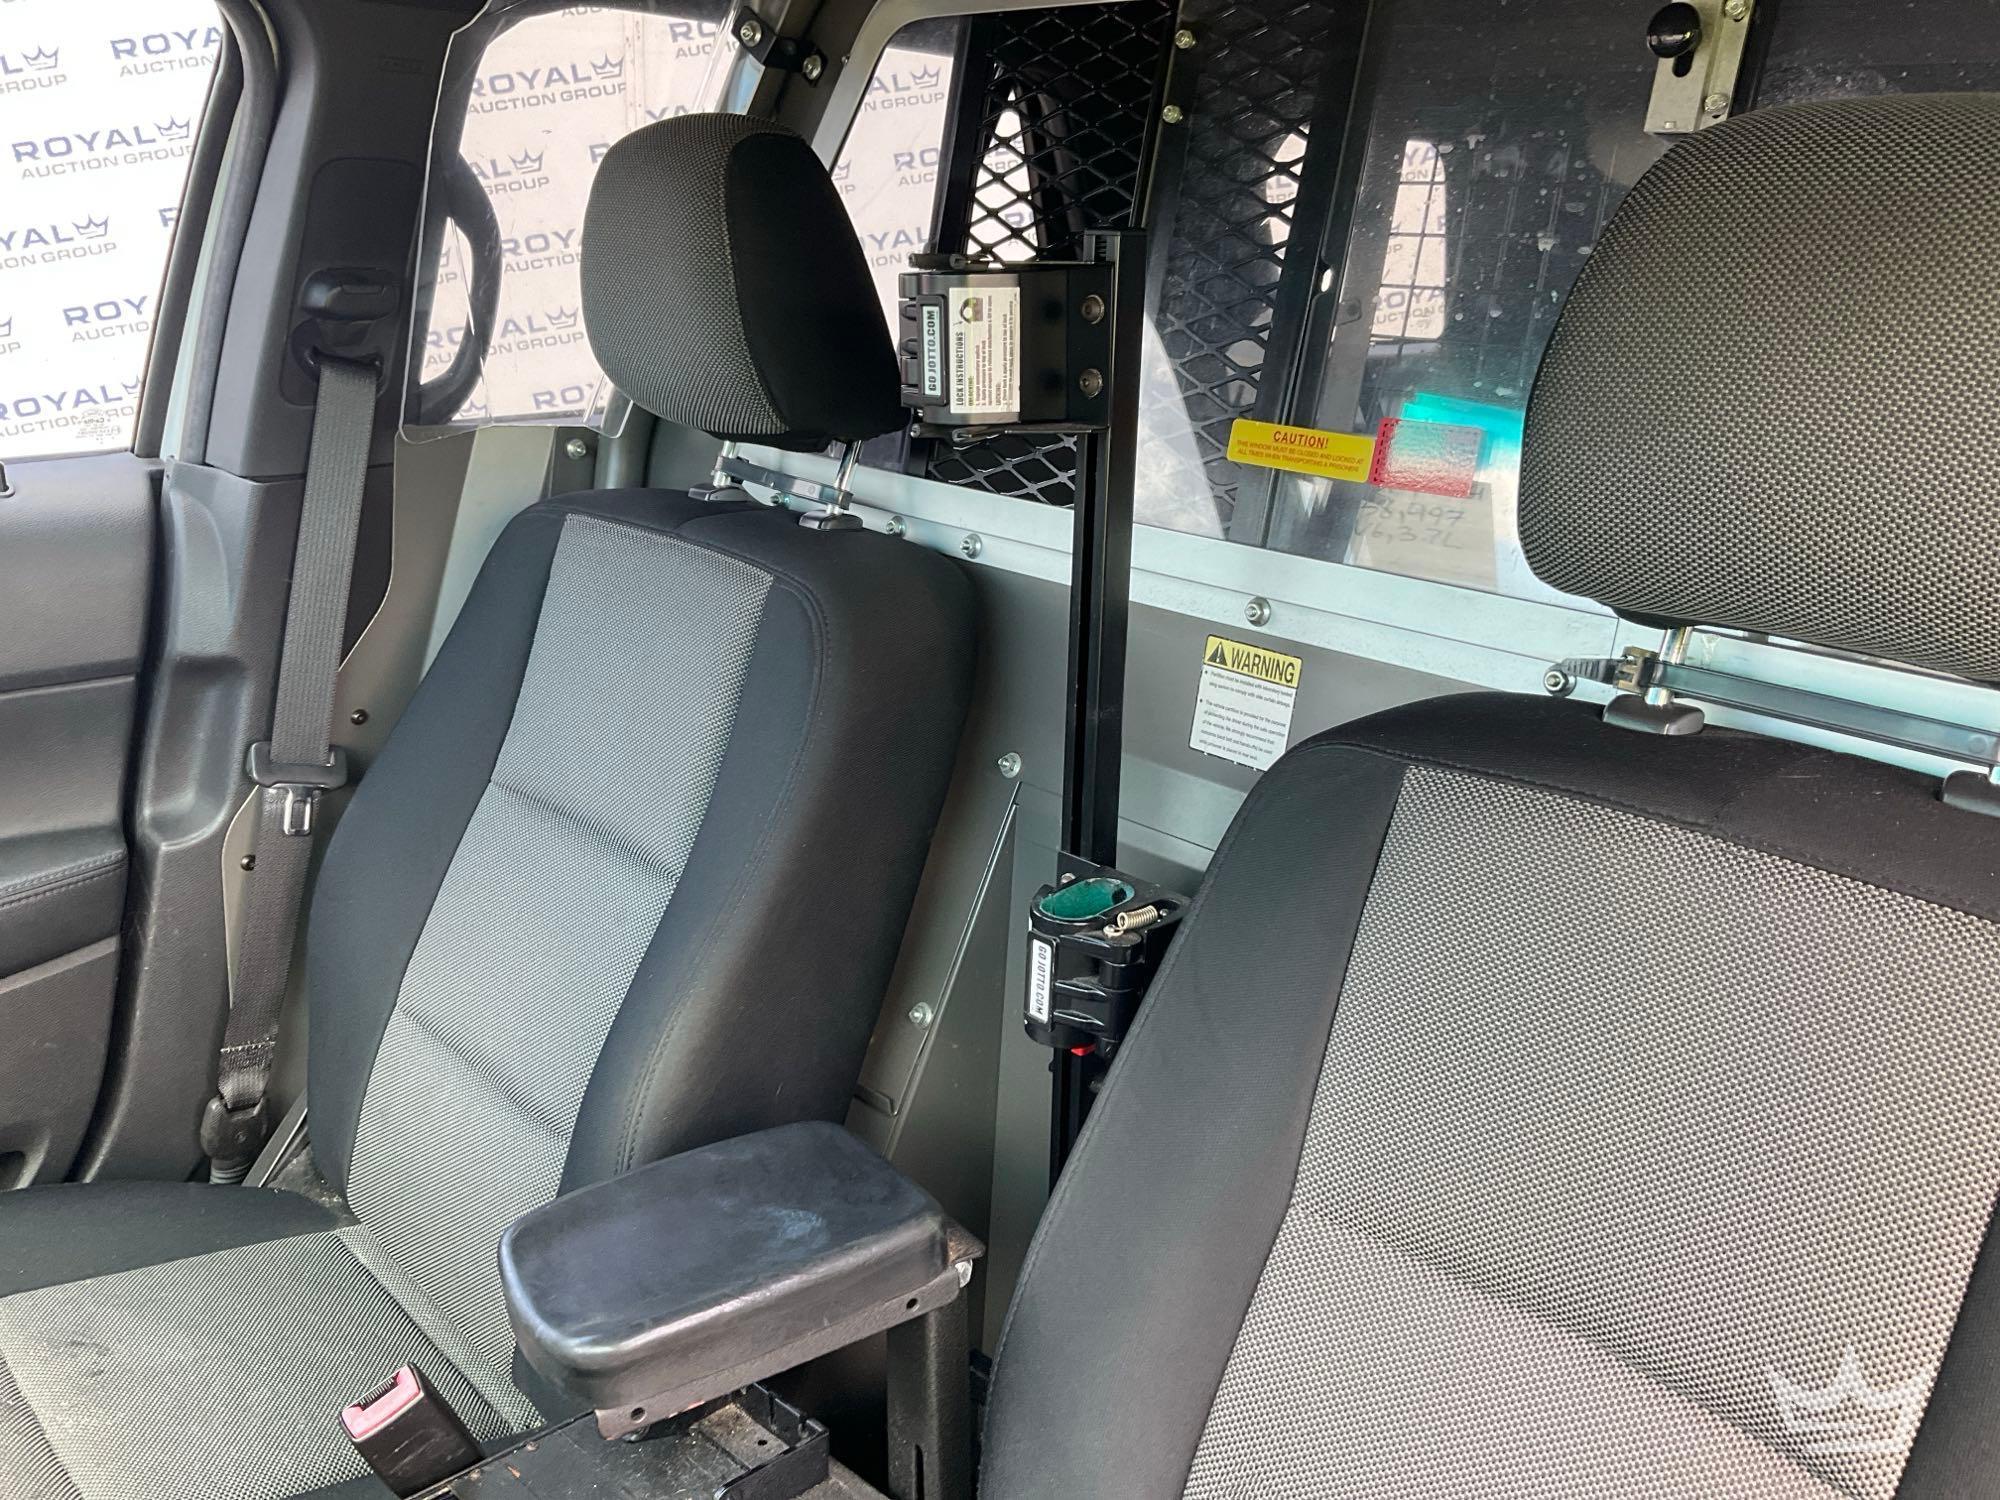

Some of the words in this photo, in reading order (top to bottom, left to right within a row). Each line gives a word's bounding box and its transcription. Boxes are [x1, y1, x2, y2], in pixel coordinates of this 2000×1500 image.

[467, 92, 558, 115] AUCTION
[881, 92, 945, 110] GROUP
[12, 126, 157, 163] ROYAL
[21, 155, 119, 180] AUCTION
[41, 242, 117, 263] GROUP
[517, 331, 585, 351] GROUP
[926, 310, 937, 373] JOTTO.COM
[955, 331, 964, 386] INSTRUCTIONS
[928, 378, 937, 392] GO
[955, 387, 964, 406] LOCK
[1273, 430, 1328, 449] CAUTION!
[1230, 647, 1296, 684] WARNING
[1038, 945, 1047, 960] GO
